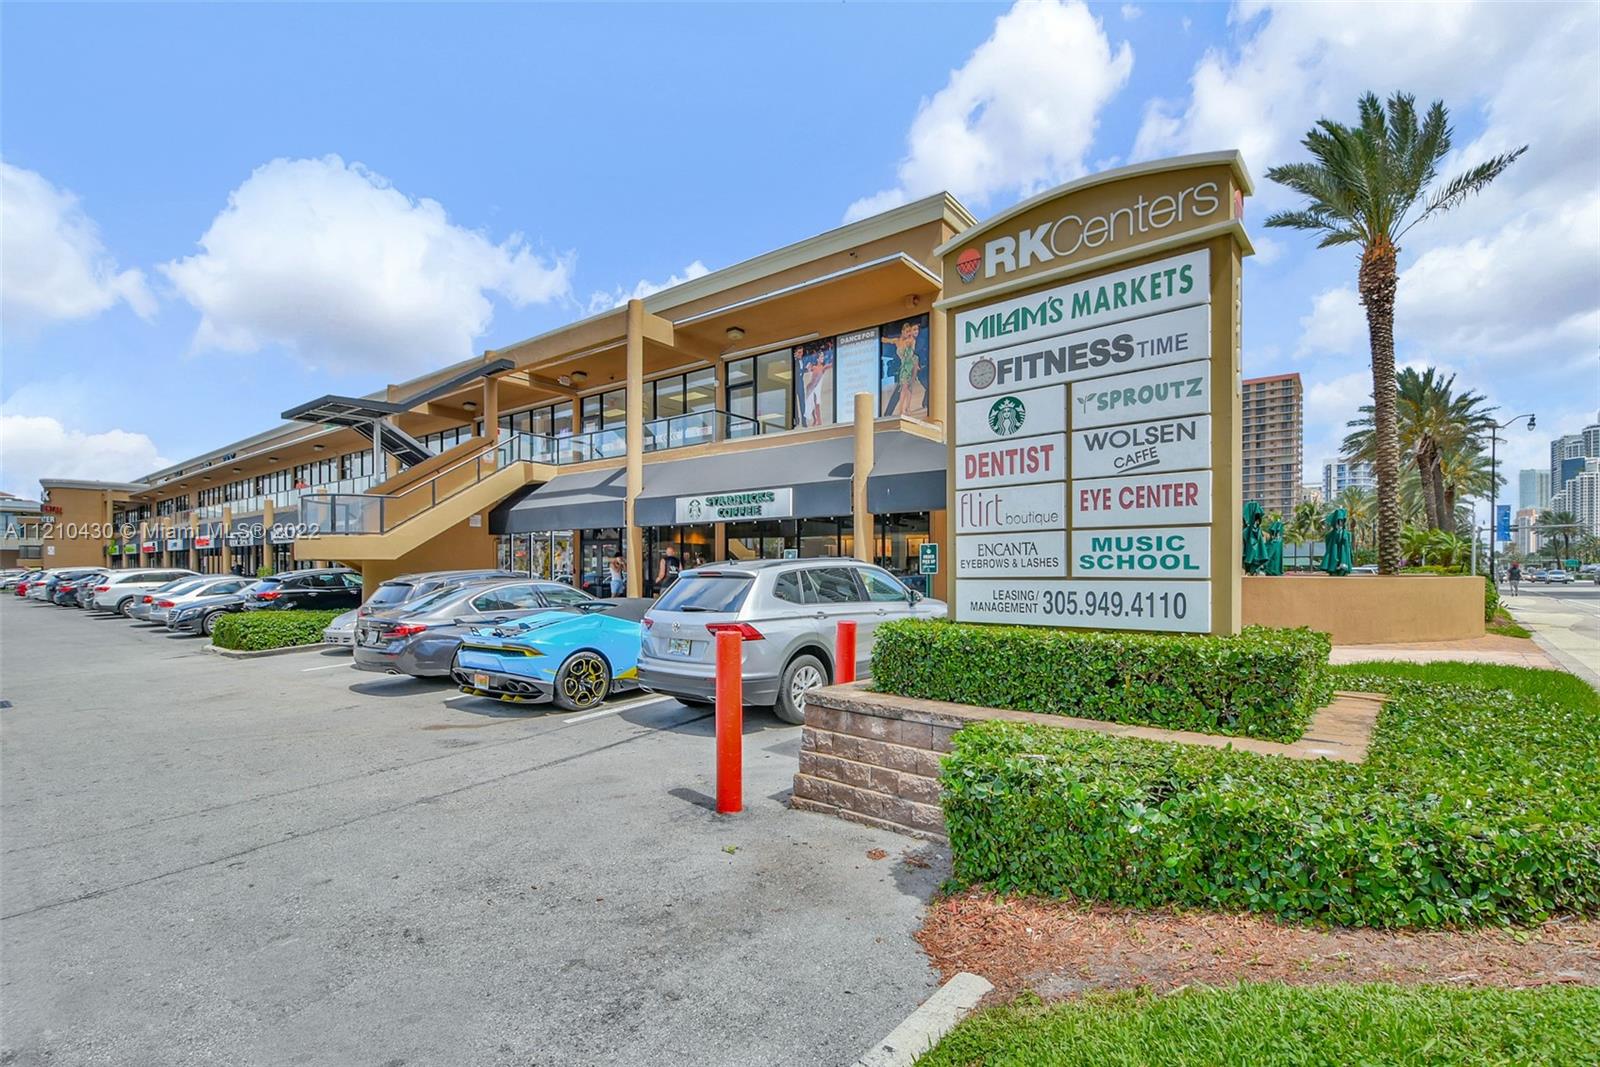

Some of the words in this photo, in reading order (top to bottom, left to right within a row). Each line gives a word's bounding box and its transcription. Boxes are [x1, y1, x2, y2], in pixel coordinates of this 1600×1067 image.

[964, 295, 1065, 344] MILAM'S
[1071, 264, 1194, 319] MARKETS
[996, 333, 1135, 385] FITNESS
[1136, 332, 1189, 359] TIME
[1096, 377, 1203, 411] SPROUTZ
[1083, 421, 1197, 451] WOLSEN
[965, 444, 1055, 480] DENTIST
[1114, 446, 1159, 469] CAFFE
[704, 491, 776, 507] STARBUCKS
[1079, 488, 1112, 512] EYE
[1118, 482, 1199, 510] CENTER
[716, 505, 763, 518] COFFEE
[960, 492, 1003, 528] flirt
[1005, 511, 1059, 527] boutique
[977, 541, 1039, 557] ENCANTA
[1091, 535, 1185, 552] MUSIC
[960, 558, 1010, 569] EYEBROWS
[1012, 558, 1018, 568] &
[1020, 557, 1059, 568] LASHES
[1079, 554, 1200, 570] SCHOOL
[992, 589, 1040, 601] LEASING/
[1042, 590, 1187, 620] 305.949.4110
[970, 602, 1038, 614] MANAGEMENT
